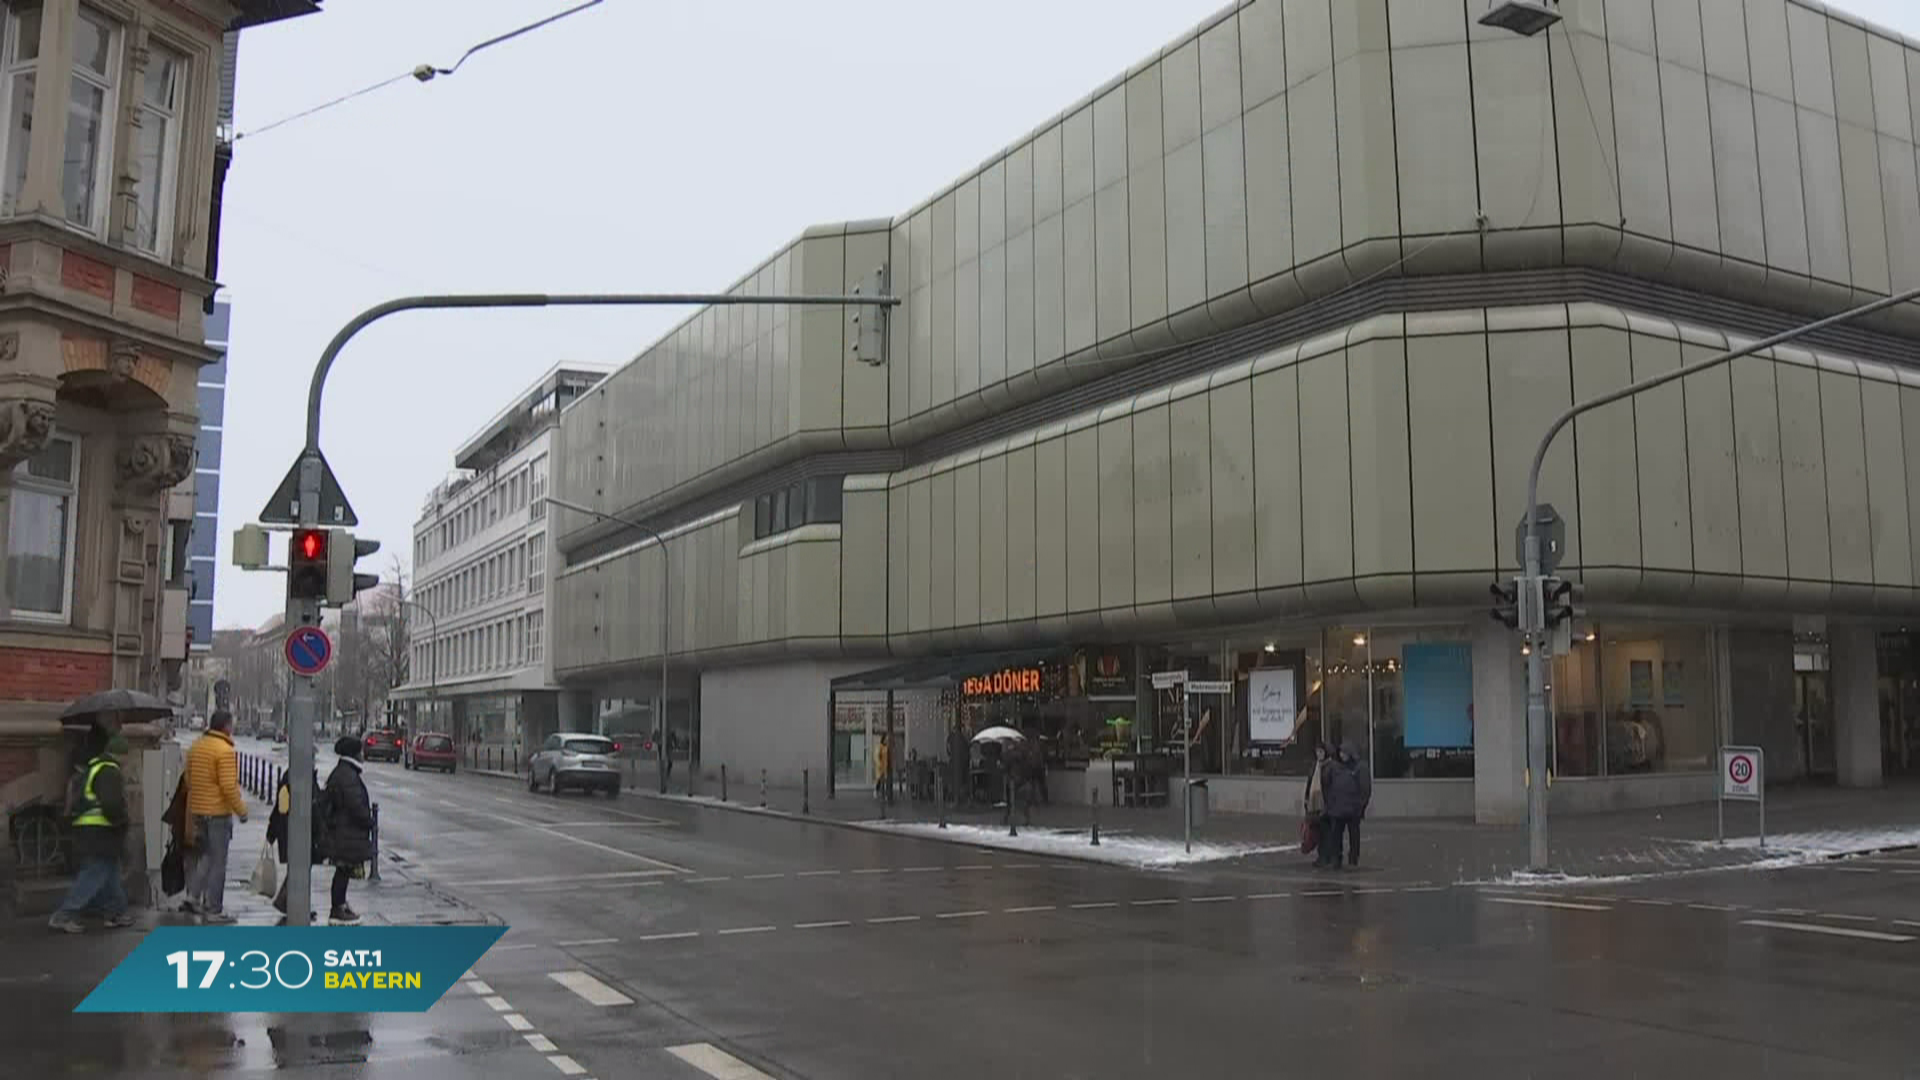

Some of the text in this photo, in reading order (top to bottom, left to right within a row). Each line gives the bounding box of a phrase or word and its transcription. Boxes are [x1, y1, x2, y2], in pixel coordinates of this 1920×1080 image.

[963, 669, 1040, 695] EGA DÖNER
[1735, 762, 1748, 777] 20
